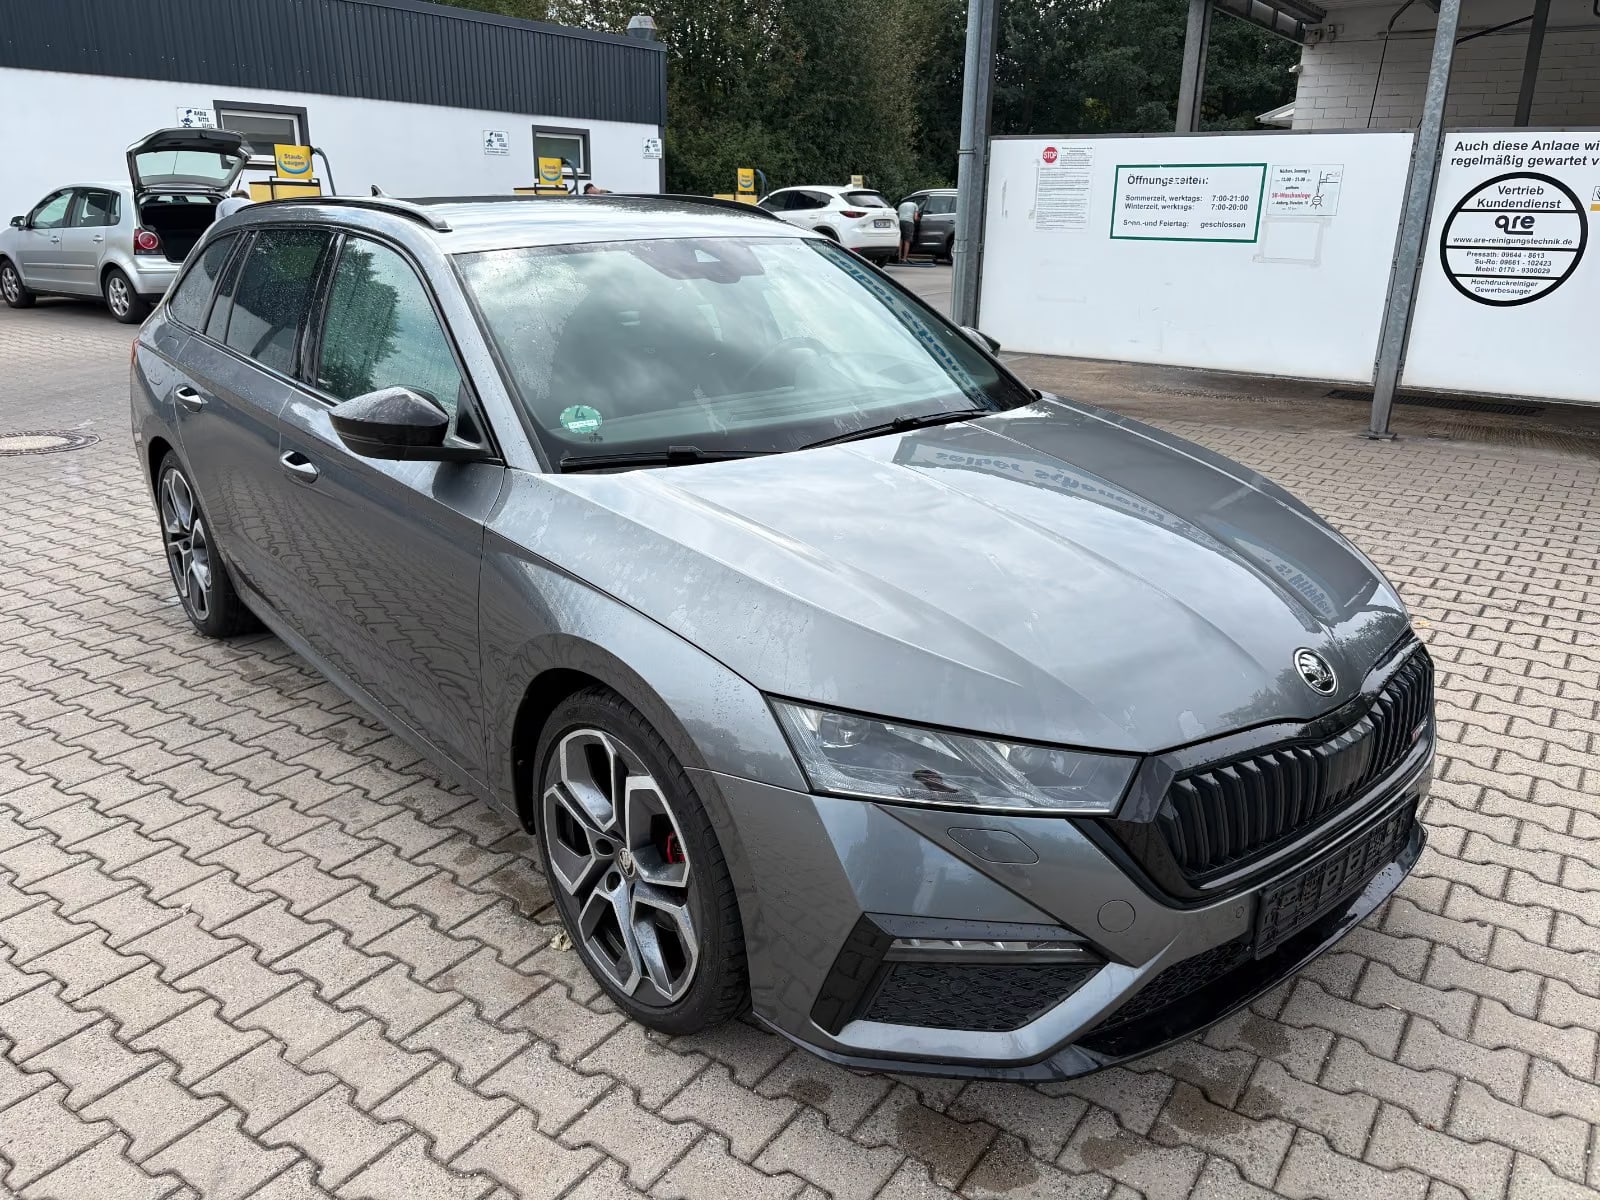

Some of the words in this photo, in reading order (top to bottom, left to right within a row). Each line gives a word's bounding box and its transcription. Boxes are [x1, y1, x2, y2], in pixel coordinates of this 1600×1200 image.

[1454, 141, 1488, 151] Auch
[1493, 140, 1528, 151] diese
[1531, 140, 1580, 151] Anlage
[1451, 154, 1523, 168] regelmäßig
[1528, 156, 1587, 168] gewartet
[1592, 157, 1600, 166] v
[1127, 173, 1209, 187] Öffnungszeiten:
[1498, 185, 1544, 195] Vertrieb
[1125, 195, 1167, 203] Sommerzeit,
[1169, 195, 1203, 203] werktags:
[1477, 198, 1562, 209] Kundendienst
[1200, 221, 1246, 229] geschlossen
[1453, 237, 1573, 246] www.are-reinigungstechnik.de
[1470, 278, 1538, 288] Hochdruckreiniger
[1474, 287, 1532, 296] Gewerbesauger
[574, 408, 586, 419] 4
